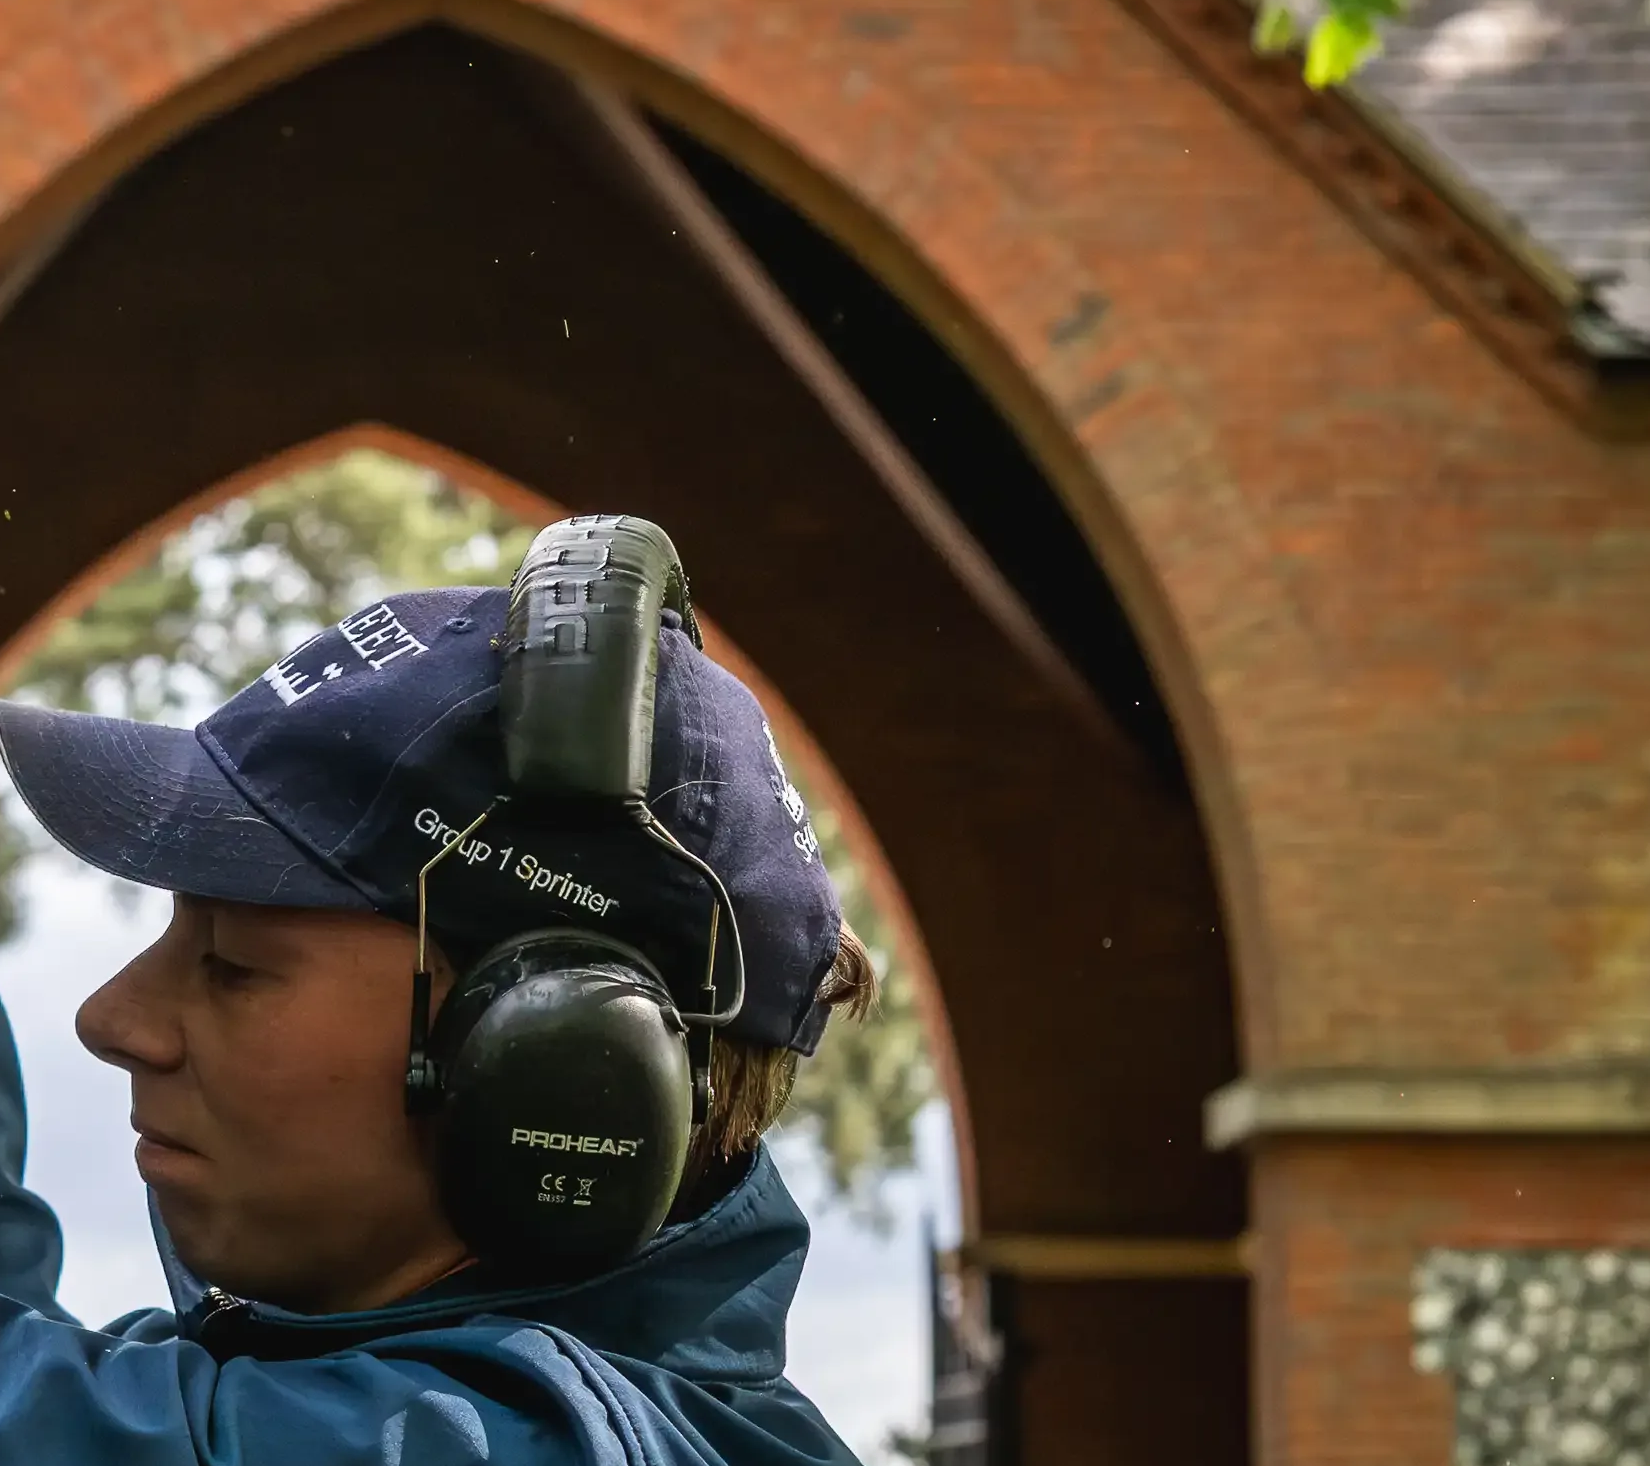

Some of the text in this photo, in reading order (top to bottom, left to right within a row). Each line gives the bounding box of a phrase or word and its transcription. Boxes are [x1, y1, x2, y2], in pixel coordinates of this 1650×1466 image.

[414, 808, 620, 917] Group 1 Sprinter
[511, 1127, 637, 1157] PROHEAR
